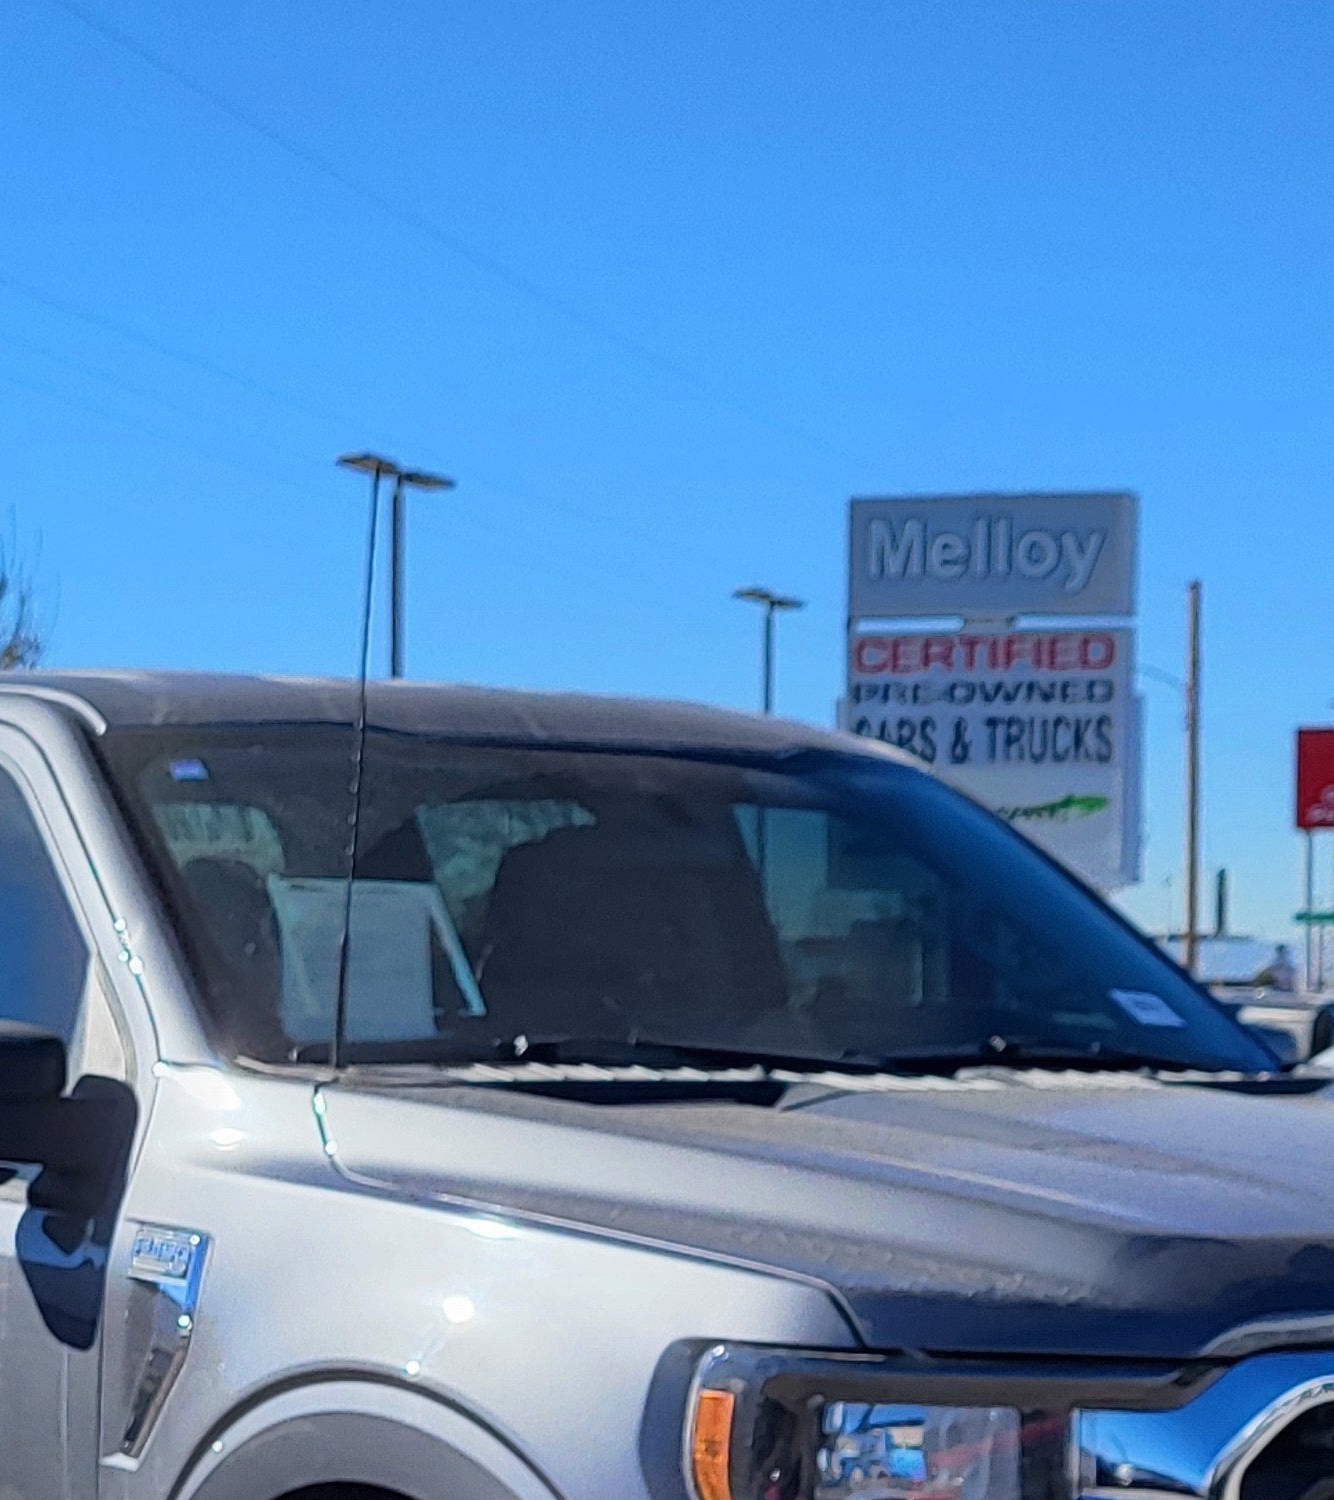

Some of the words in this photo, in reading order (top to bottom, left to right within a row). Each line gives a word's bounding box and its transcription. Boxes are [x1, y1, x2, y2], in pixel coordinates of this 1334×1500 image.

[869, 516, 1107, 593] Melloy
[854, 634, 1116, 674] CERTIFIED
[950, 715, 973, 765] &
[985, 713, 1114, 765] TRUCKS
